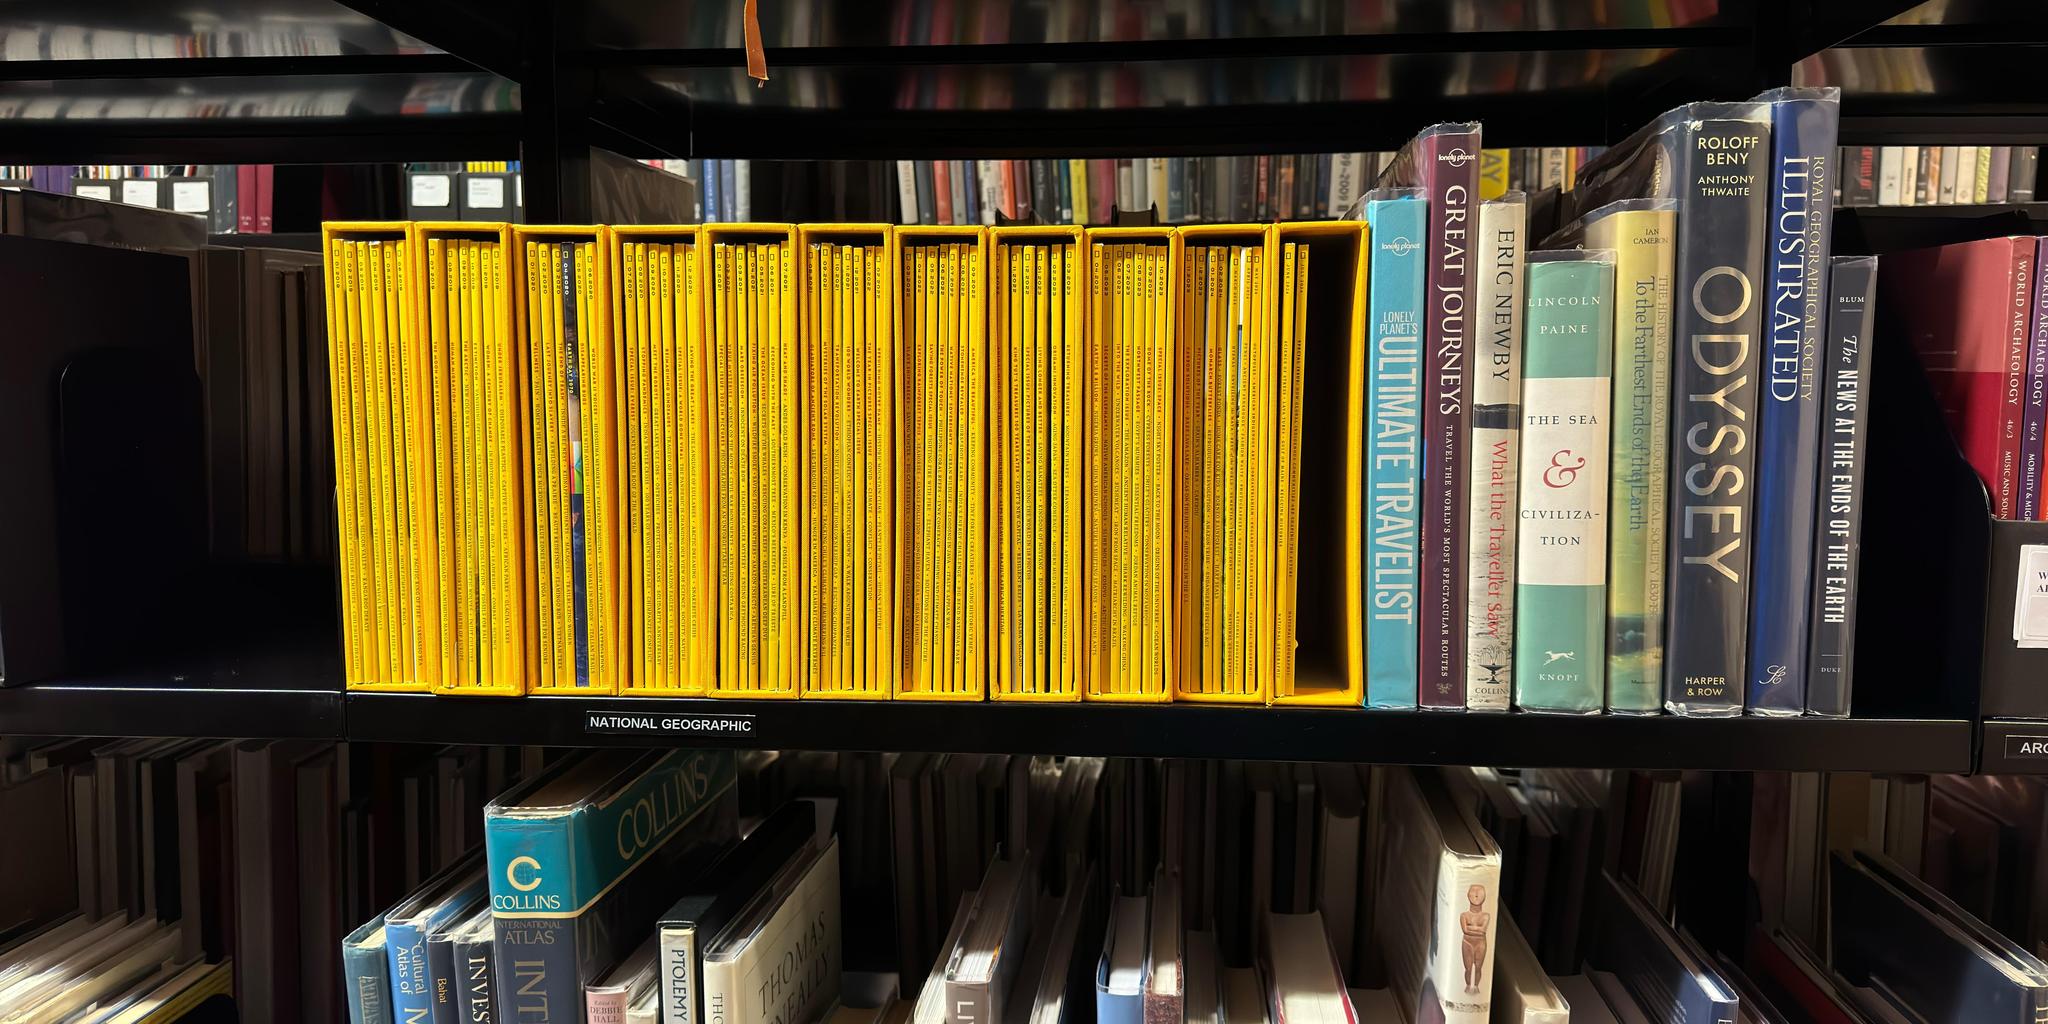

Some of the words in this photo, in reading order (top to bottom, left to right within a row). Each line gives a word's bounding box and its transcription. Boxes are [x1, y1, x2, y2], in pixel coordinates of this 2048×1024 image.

[1698, 136, 1759, 149] ROLOFF
[1438, 154, 1456, 162] lonely
[1457, 154, 1476, 162] planet
[1707, 152, 1748, 166] BENY
[1698, 175, 1754, 184] ANTHONY
[1702, 187, 1750, 196] THWAITE
[1812, 156, 1825, 206] ROYAL
[1442, 185, 1466, 277] GREAT
[1633, 237, 1669, 245] CAMERON
[1646, 228, 1660, 236] IAN
[1382, 243, 1400, 252] lonely
[1400, 242, 1420, 250] planet
[1496, 229, 1514, 286] ERIC
[1772, 156, 1809, 402] ILLUSTRATED
[1804, 211, 1822, 332] GEOGRAPHICAL
[2014, 260, 2028, 307] WORLD
[1636, 276, 1655, 296] To
[1658, 274, 1668, 299] THE
[1528, 296, 1602, 308] LINCOLN
[1635, 298, 1654, 324] the
[1380, 323, 1418, 335] PLANET'S
[1384, 310, 1415, 323] LONELY
[1540, 324, 1588, 334] PAINE
[1656, 302, 1668, 348] HISTORY
[1437, 284, 1465, 415] JOURNEYS
[1492, 296, 1514, 383] NEWBY
[1842, 335, 1858, 364] The
[1633, 326, 1654, 391] Farthest
[1656, 350, 1666, 364] OF
[1800, 337, 1815, 401] SOCIETY
[2008, 311, 2024, 406] ARCHAEOLOGY
[2032, 313, 2048, 408] ARCHAEOLOGY
[1655, 370, 1666, 392] THE
[1836, 370, 1858, 412] NEWS
[1376, 336, 1418, 470] ULTIMATE
[1632, 394, 1652, 436] Ends
[1654, 396, 1665, 432] ROYAL
[1528, 416, 1560, 425] THE
[1570, 415, 1598, 425] SEA
[1684, 266, 1752, 584] ODYSSEY
[1834, 418, 1856, 435] AT
[2006, 418, 2014, 438] 46/3
[2030, 421, 2038, 441] 46/4
[1445, 424, 1454, 462] TRAVEL
[1631, 437, 1651, 452] of
[1832, 441, 1854, 468] THE
[1444, 465, 1453, 485] THE
[1490, 440, 1508, 490] What
[1542, 449, 1586, 488] &
[2002, 450, 2012, 476] MUSIC
[2025, 453, 2035, 492] MOBILITY
[1651, 434, 1663, 524] GEOGRAPHICAL
[2001, 478, 2010, 496] AND
[1490, 492, 1508, 520] the
[1629, 484, 1649, 530] Earth
[1830, 475, 1852, 514] ENDS
[1444, 488, 1452, 534] WORLD'S
[1521, 509, 1600, 520] CIVILIZA-
[1540, 536, 1581, 546] TION
[1829, 520, 1850, 538] OF
[1374, 482, 1416, 625] TRAVELIST
[1442, 537, 1451, 564] MOST
[1488, 524, 1506, 598] Traveller
[1650, 529, 1662, 576] SOCIETY
[1827, 544, 1848, 570] THE
[1441, 568, 1450, 636] SPECTACULAR
[1824, 577, 1846, 623] EARTH
[1487, 603, 1502, 638] Saw
[1440, 639, 1449, 678] ROUTES
[1539, 674, 1579, 682] KNOPF
[1685, 676, 1726, 686] HARPER
[1688, 688, 1695, 696] &
[1697, 688, 1723, 696] ROW
[590, 716, 658, 729] NATIONAL
[662, 718, 752, 732] GEOGRAPHIC
[618, 753, 708, 860] COLLINS
[494, 894, 561, 910] COLLINS
[496, 920, 563, 928] INTERNATIONAL
[504, 930, 555, 944] ATLAS
[396, 946, 409, 976] Atlas
[411, 945, 428, 994] Cultural
[758, 910, 825, 1018] THOMAS
[399, 981, 414, 994] of
[437, 978, 448, 1004] Bahat
[670, 950, 688, 1021] PTOLEMY
[590, 1006, 622, 1014] DEBBIE
